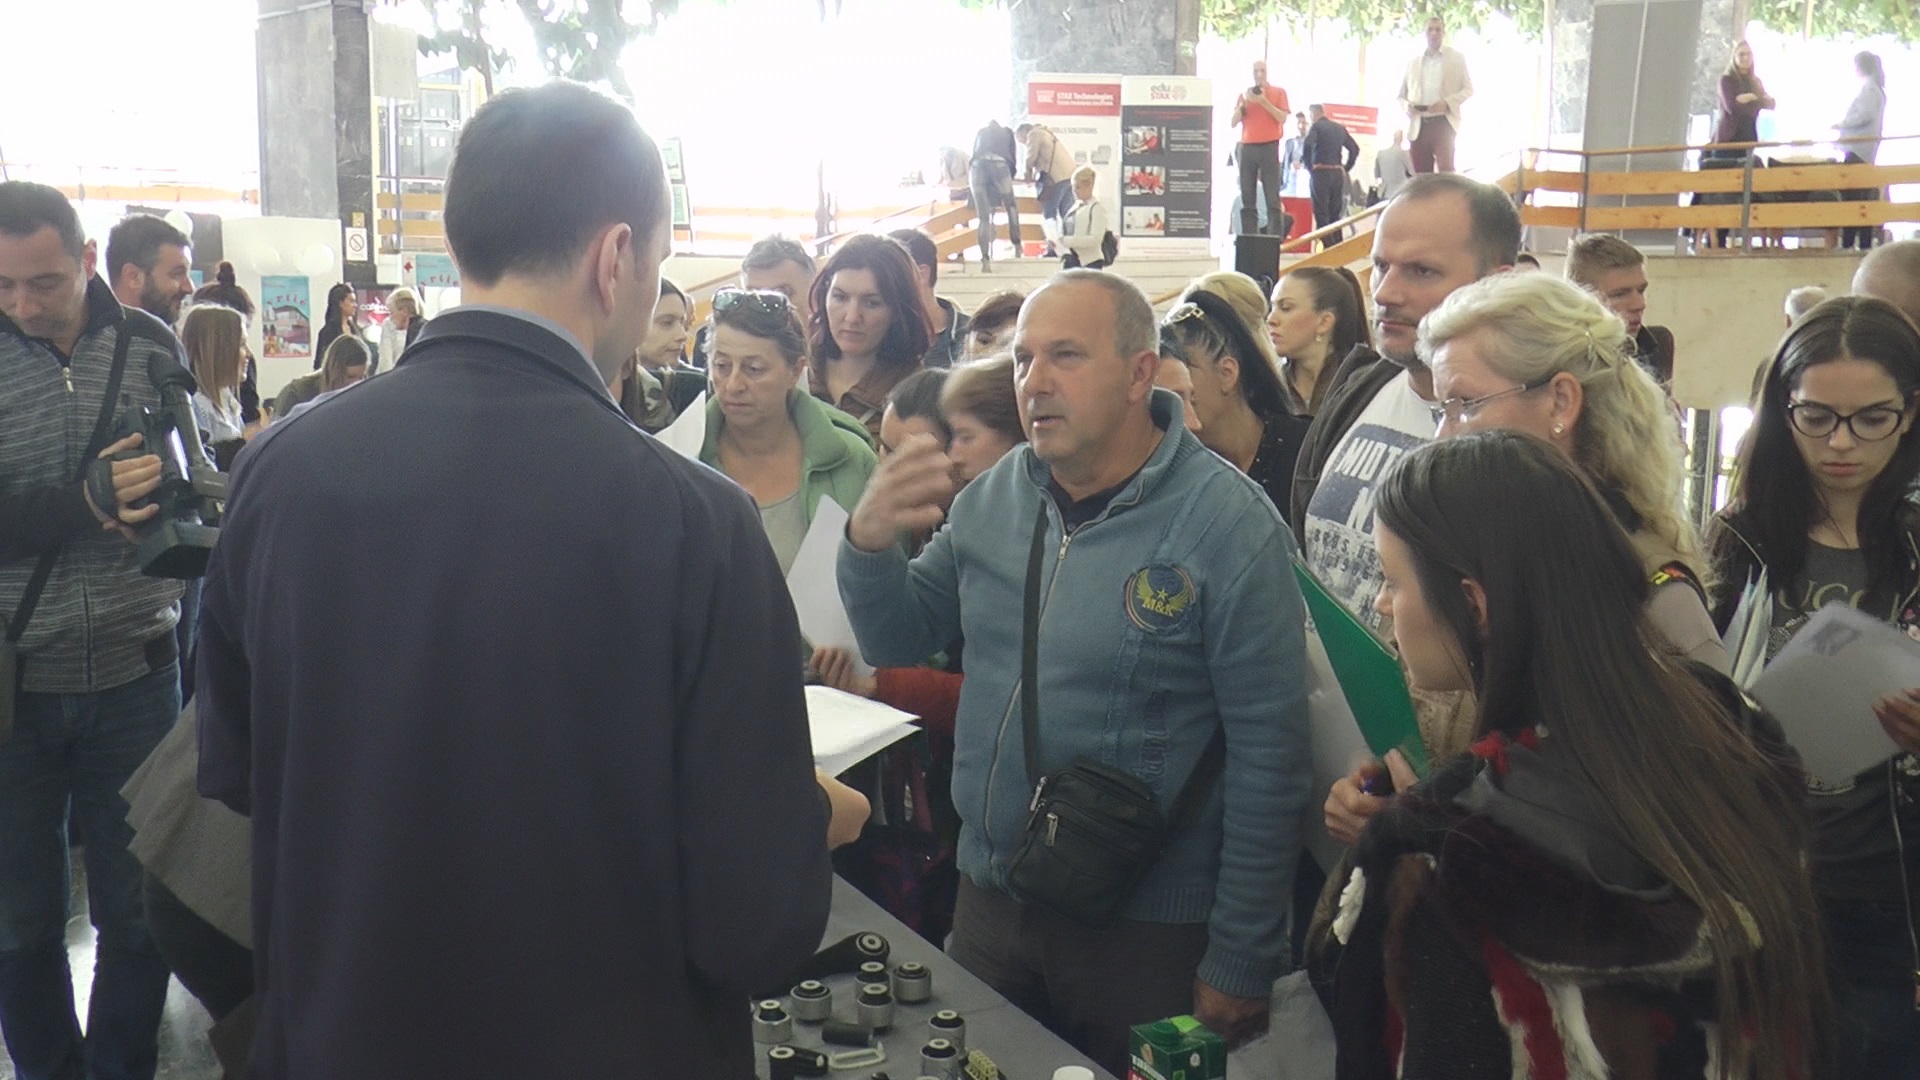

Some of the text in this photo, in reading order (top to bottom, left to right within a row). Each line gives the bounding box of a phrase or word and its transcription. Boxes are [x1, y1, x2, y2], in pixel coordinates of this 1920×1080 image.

[1150, 83, 1171, 92] edu
[1073, 92, 1114, 102] Technologies
[1150, 92, 1170, 100] STAX
[1334, 436, 1402, 488] MIDT
[1142, 598, 1174, 617] M&K
